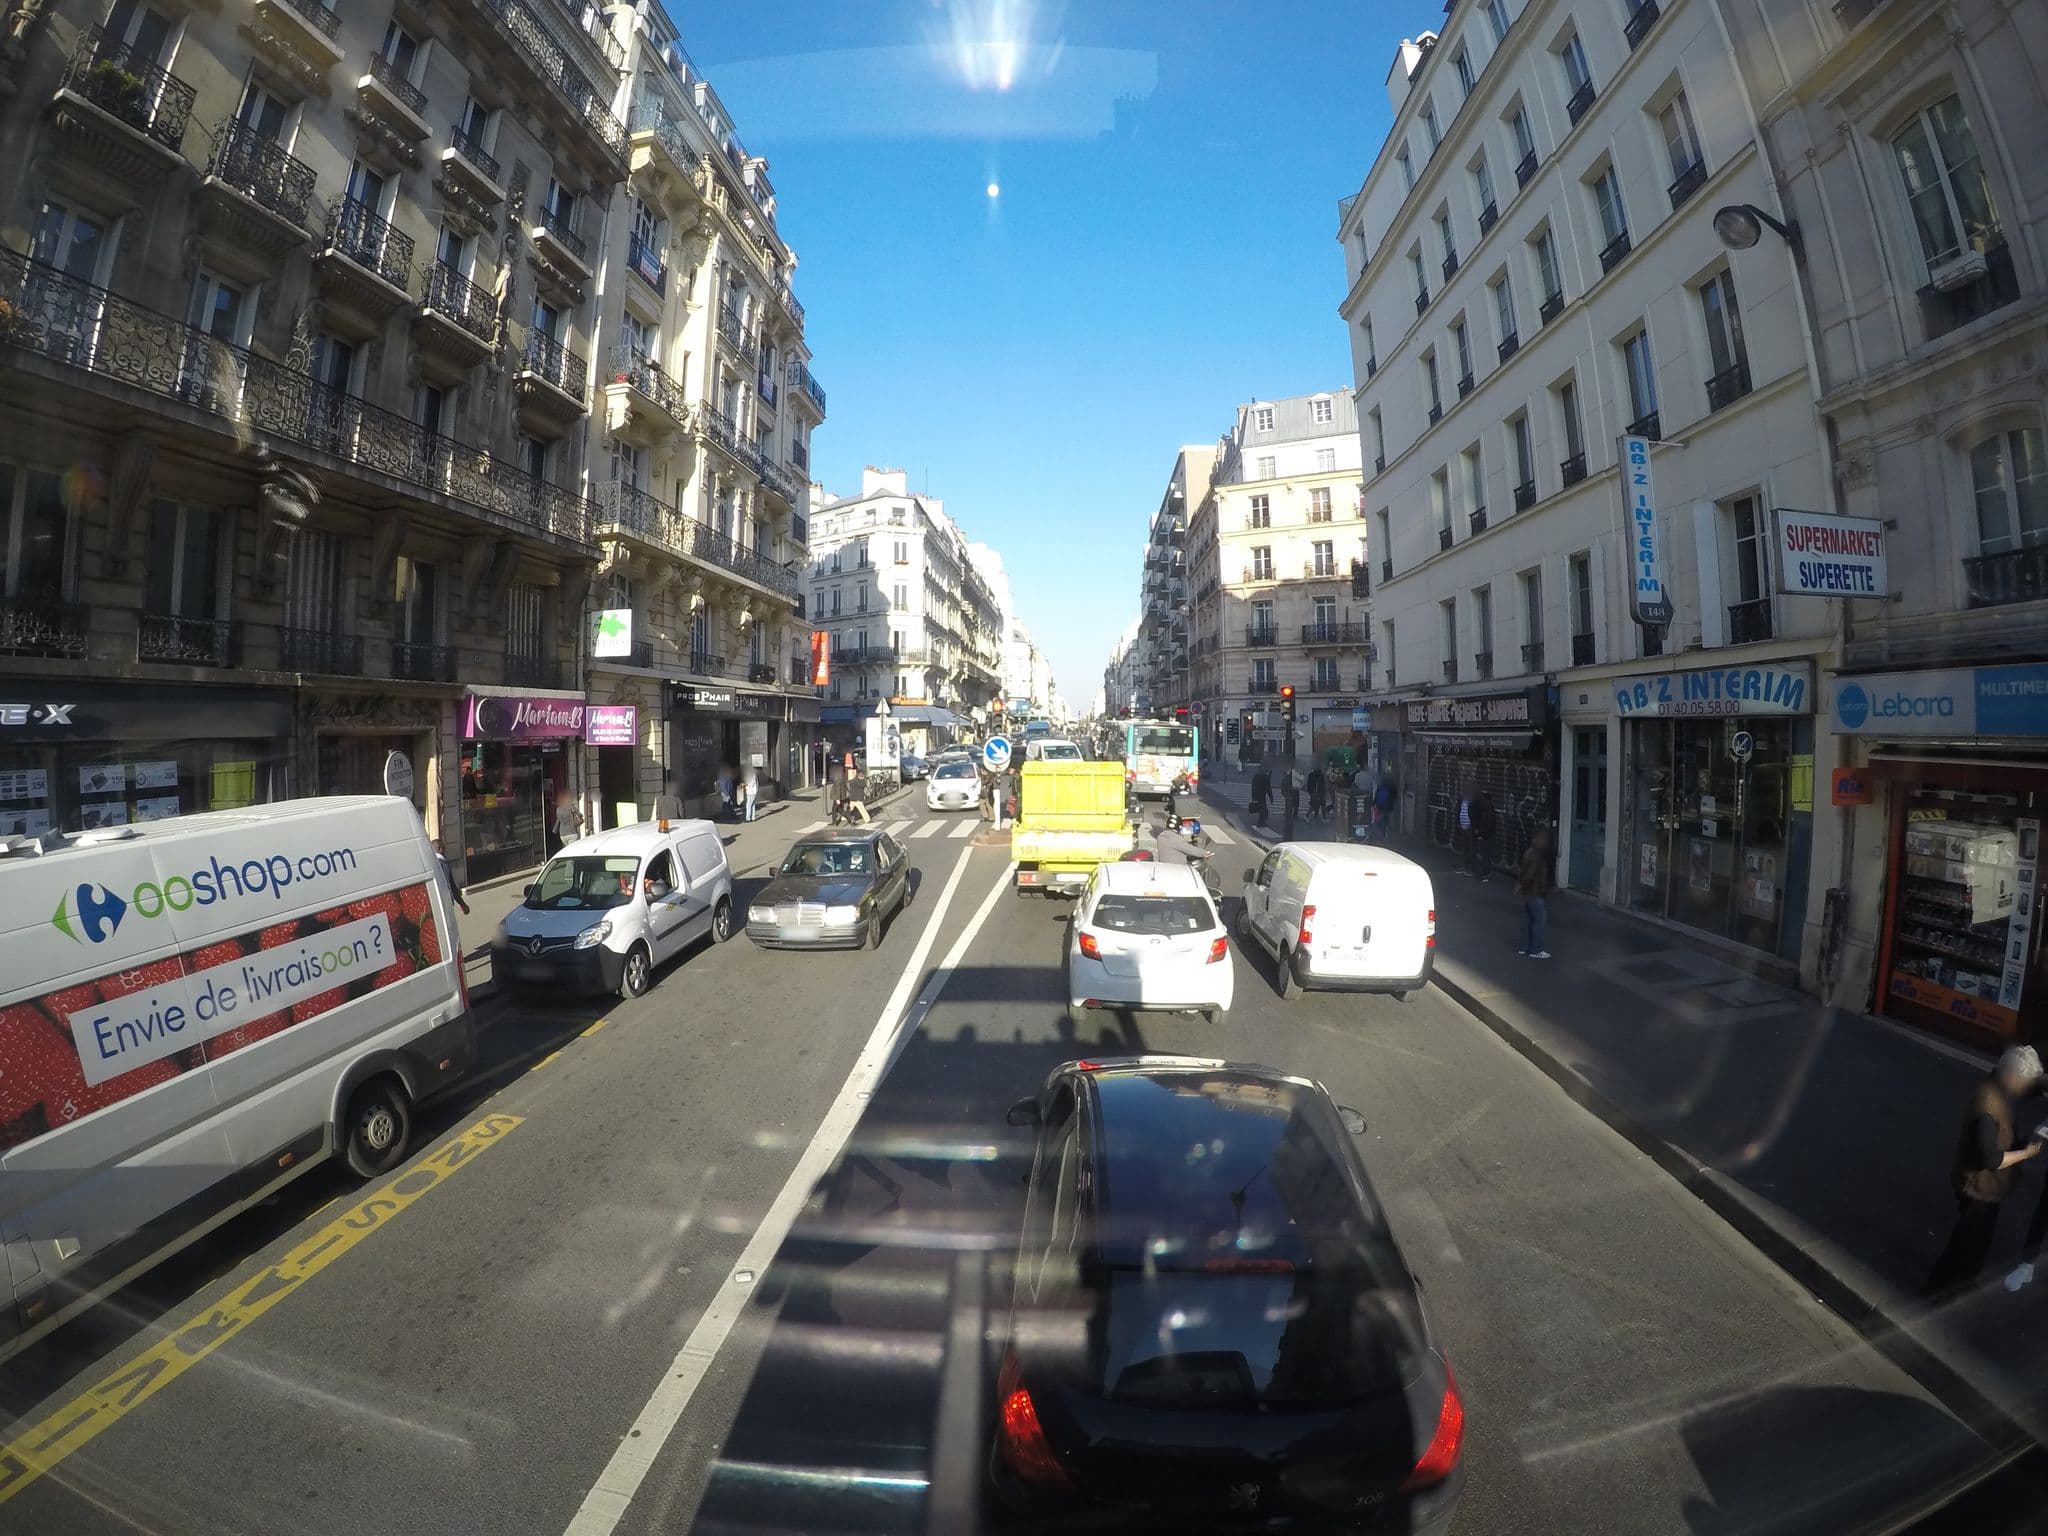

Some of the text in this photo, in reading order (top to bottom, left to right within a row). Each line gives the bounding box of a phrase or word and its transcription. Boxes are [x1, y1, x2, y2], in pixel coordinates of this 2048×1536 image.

[1635, 494, 1660, 592] INTERIM
[1786, 524, 1880, 557] SUPERMARKET
[1799, 561, 1875, 592] SUPERETTE
[1647, 606, 1665, 617] 148
[1682, 670, 1805, 711] INTERIM
[1980, 679, 2048, 697] MULTIME
[1658, 700, 1740, 716] 01.40.05.58.00
[1872, 692, 1954, 717] Lebara
[133, 845, 357, 919] ooshop.com
[93, 1000, 187, 1060] Envie
[196, 979, 238, 1021] de
[242, 939, 368, 1004] livraisoon
